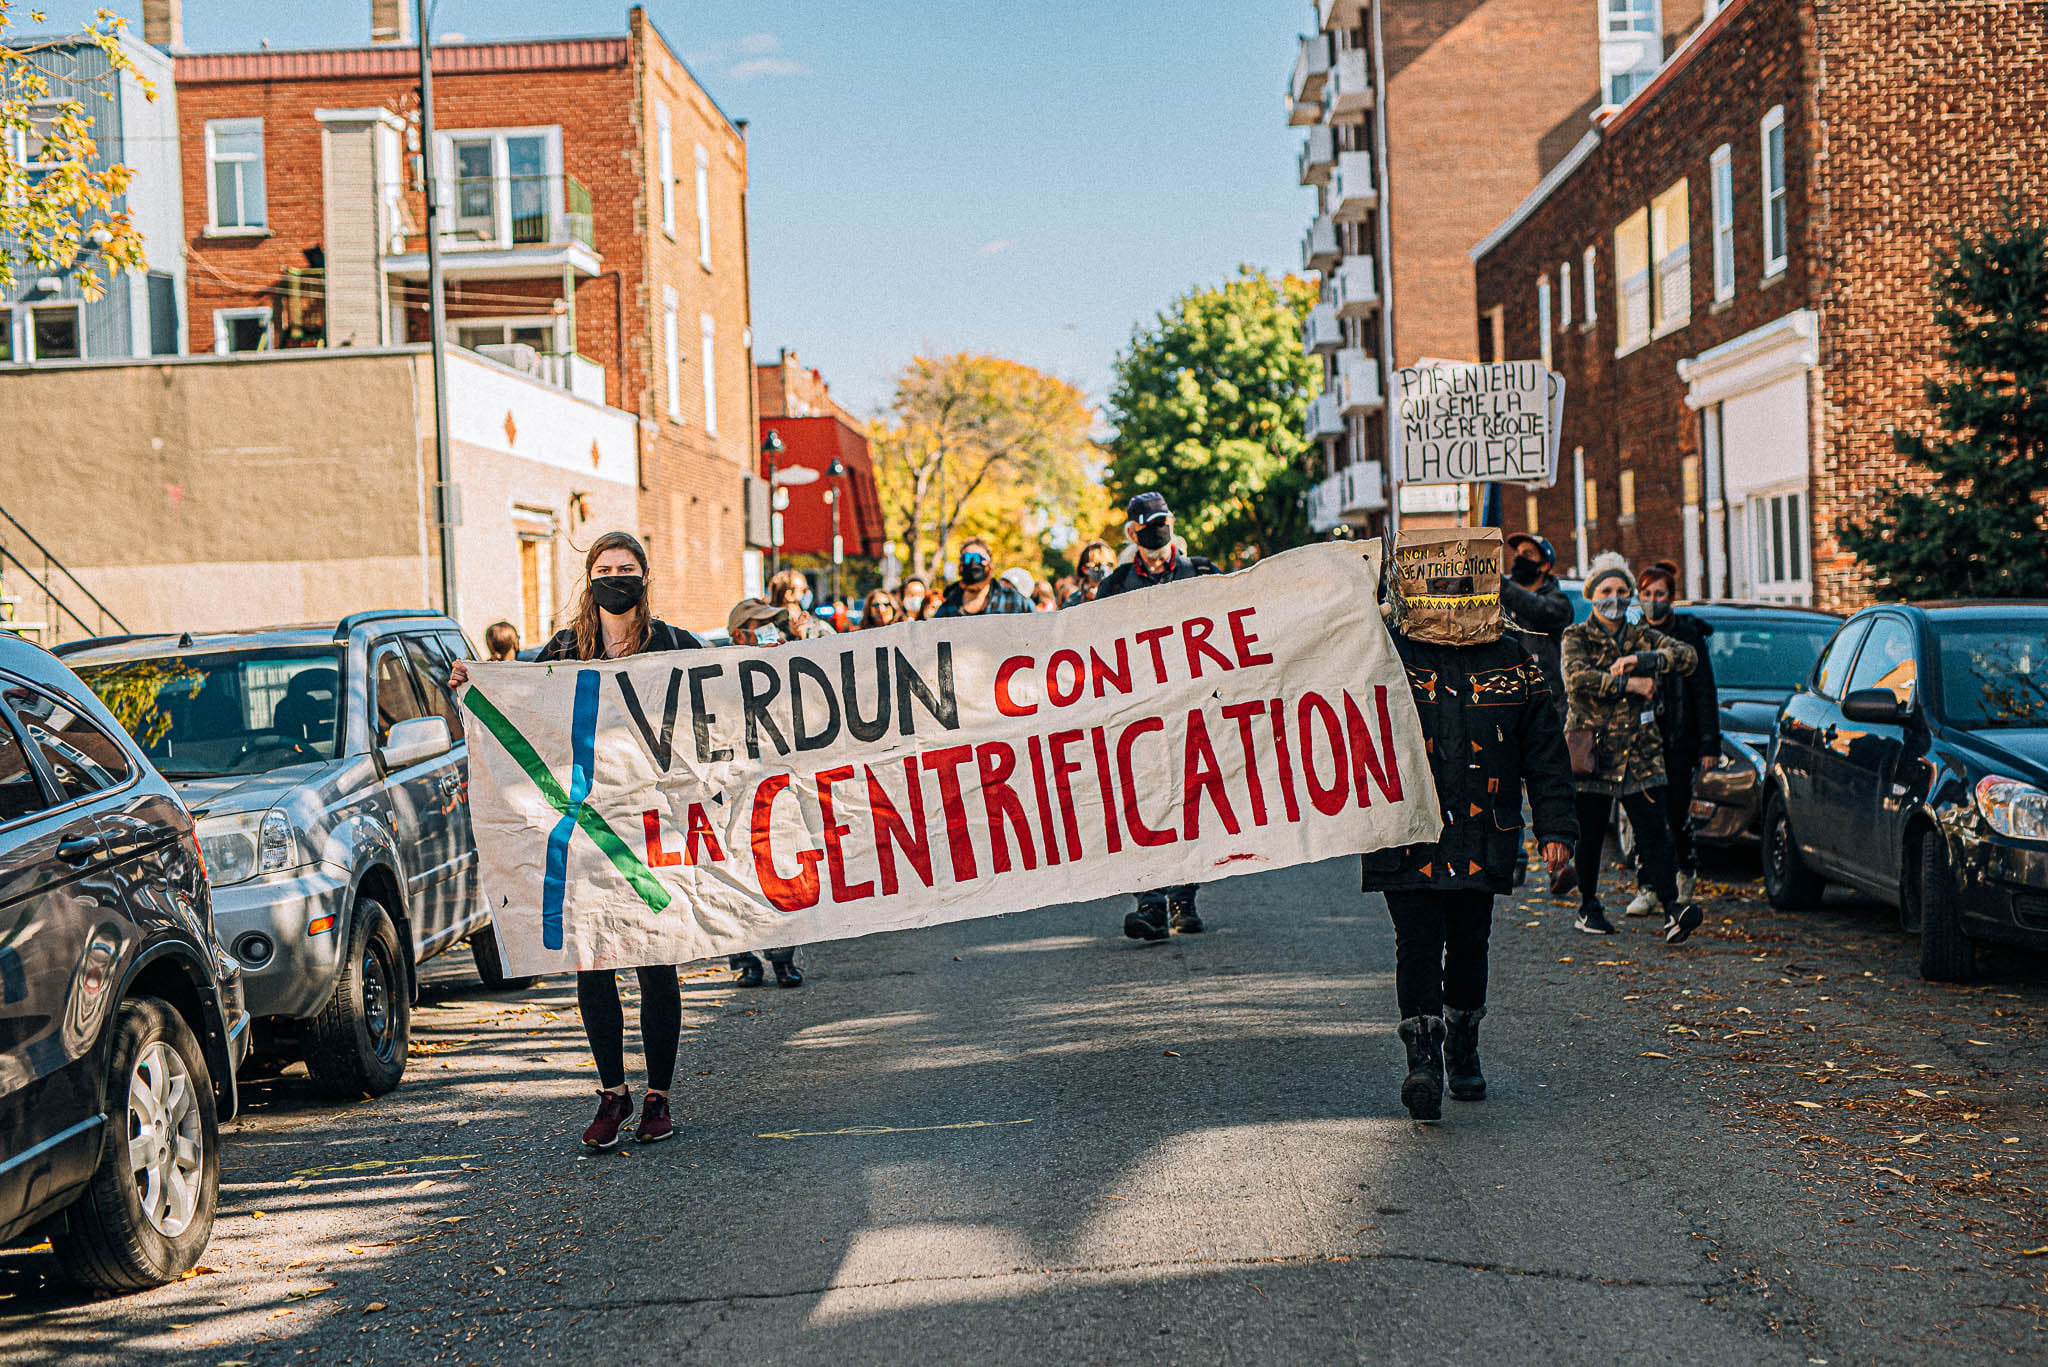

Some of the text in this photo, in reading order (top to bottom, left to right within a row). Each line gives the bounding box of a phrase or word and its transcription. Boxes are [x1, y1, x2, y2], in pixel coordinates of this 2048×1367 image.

[1401, 396, 1430, 423] QUI
[1494, 391, 1522, 415] LA
[1406, 435, 1546, 482] LA COLÈRE!
[1402, 549, 1430, 562] NON
[616, 606, 1274, 773] VERDUN CONTRE
[642, 684, 1404, 912] LA GENTRIFICATION
